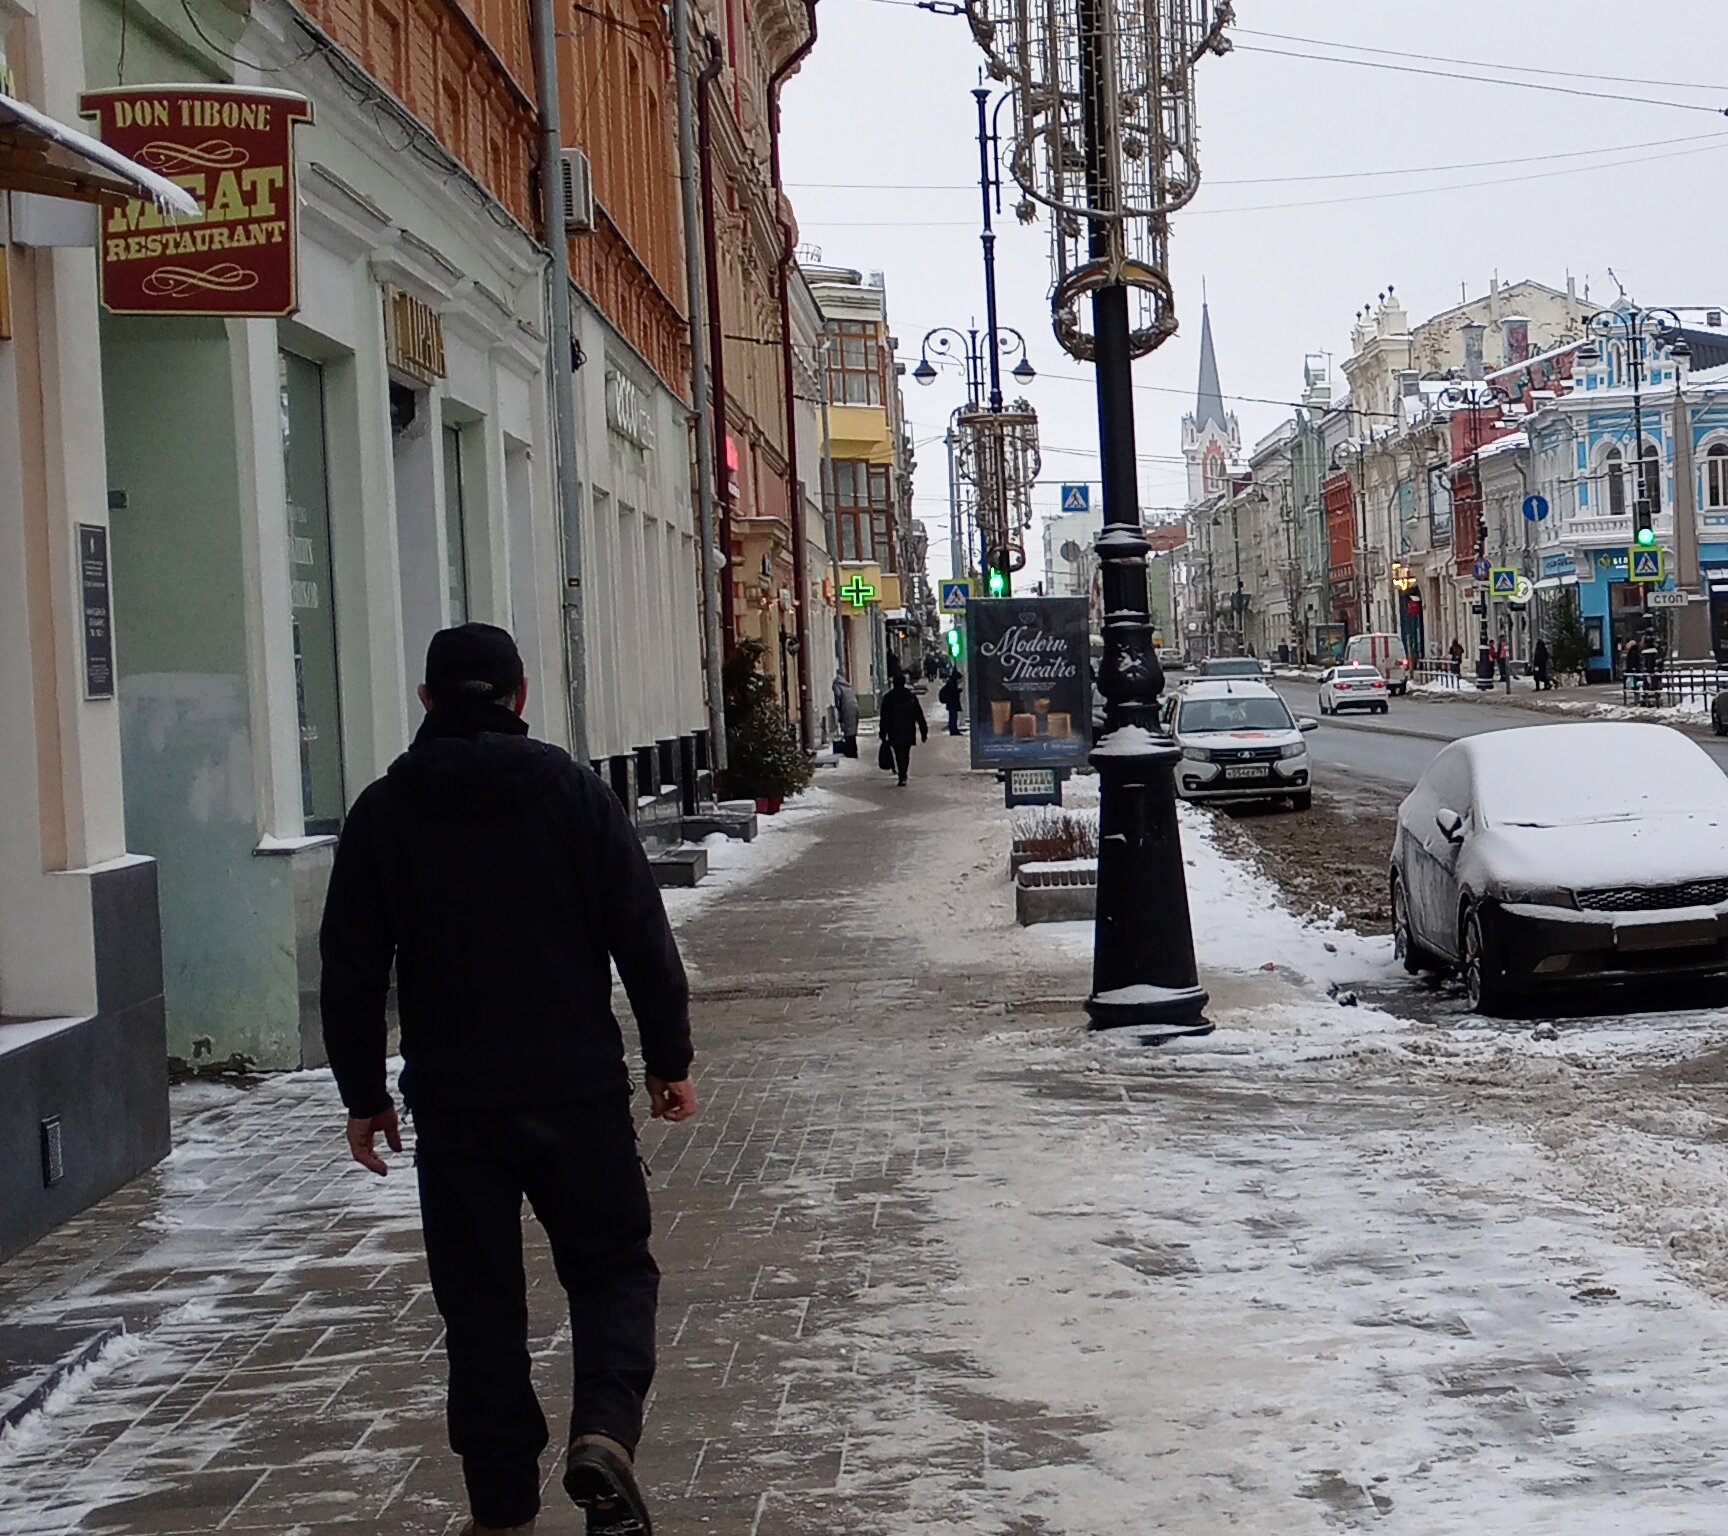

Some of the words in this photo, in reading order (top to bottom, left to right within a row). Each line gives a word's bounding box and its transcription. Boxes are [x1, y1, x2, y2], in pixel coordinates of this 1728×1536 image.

[114, 99, 169, 129] DON
[177, 99, 271, 131] TIBONE
[106, 221, 286, 262] RESTAURANT
[1653, 594, 1684, 604] СТОП
[980, 625, 1068, 656] Modern
[1000, 652, 1077, 682] Theatre
